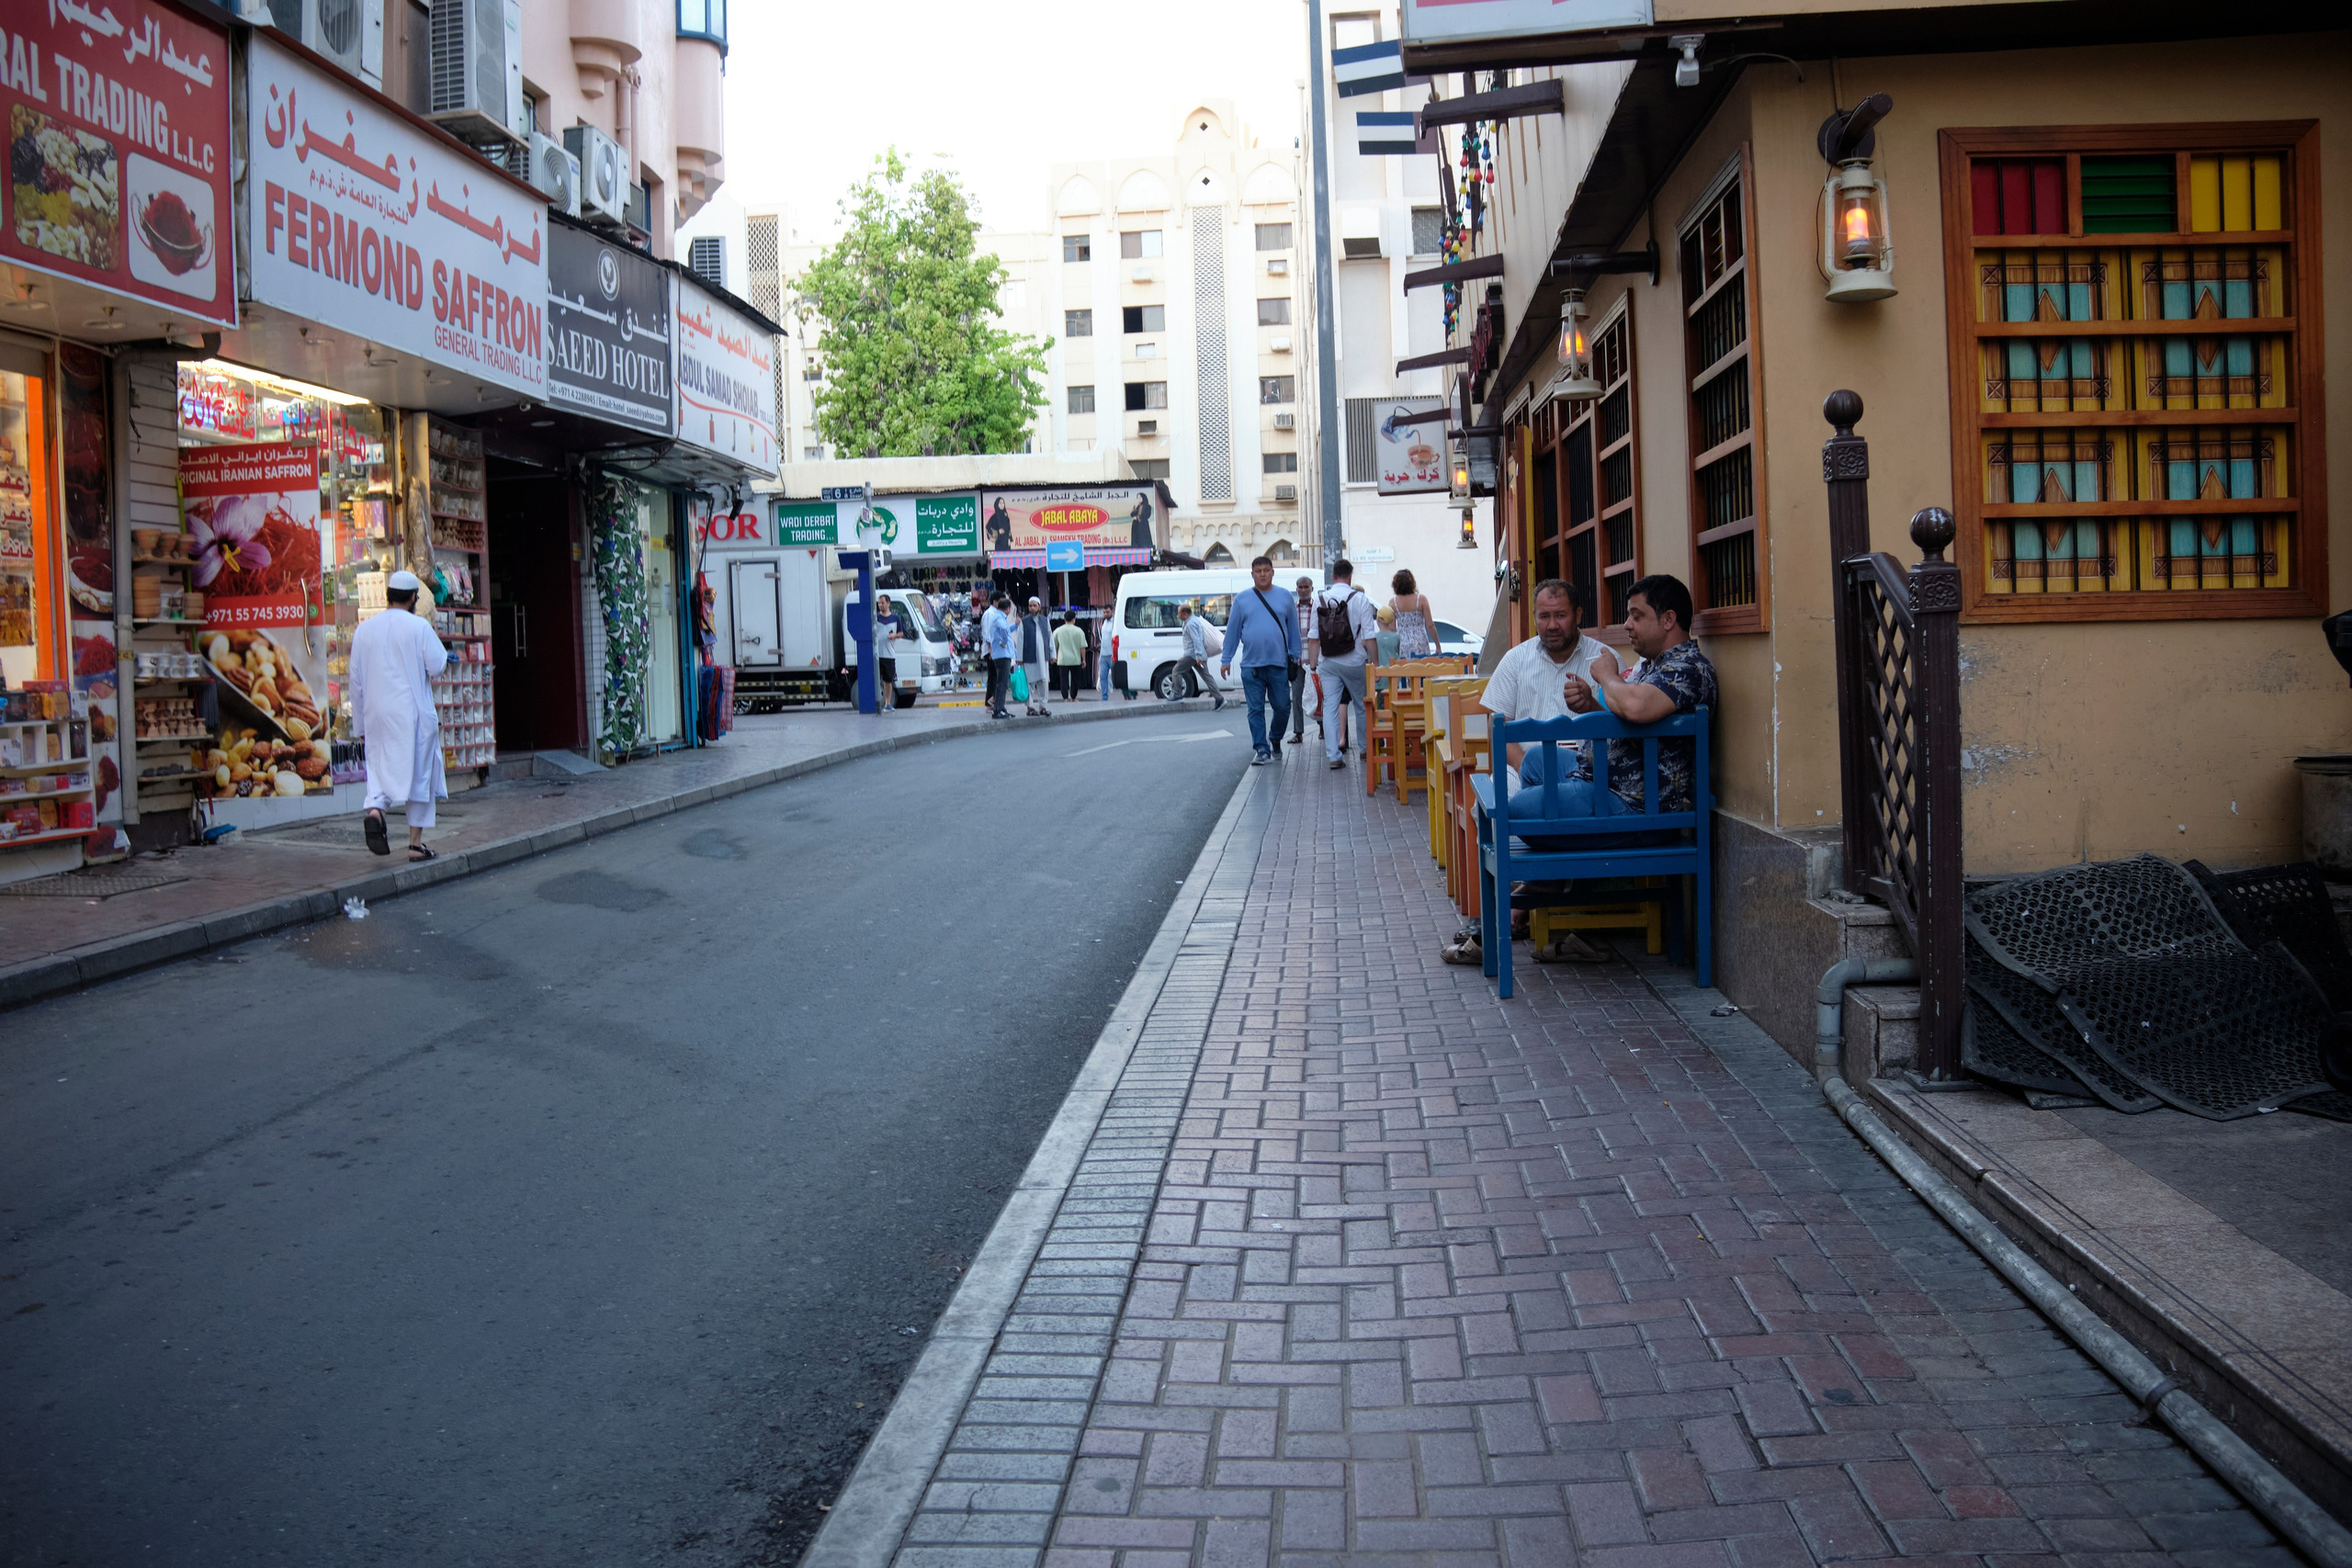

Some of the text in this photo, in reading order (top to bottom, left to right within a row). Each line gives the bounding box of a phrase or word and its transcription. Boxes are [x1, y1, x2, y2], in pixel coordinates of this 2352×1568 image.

[54, 52, 168, 155] TRADING
[173, 130, 214, 174] L.L.C
[265, 83, 540, 265] فرمند زعفران
[349, 178, 377, 209] العامة
[379, 195, 409, 225] للتجارة
[266, 180, 541, 361] FERMOND SAFFRON
[620, 306, 669, 344] فندق
[676, 303, 713, 340] شعيب
[435, 325, 542, 385] GENERAL TRADING L.L.C
[548, 321, 670, 400] SAEED HOTEL
[558, 385, 570, 397] +971
[599, 398, 613, 409] Email:
[706, 365, 732, 406] SAMAD
[180, 464, 311, 484] RIGINAL IRANIAN SAFFRON
[835, 488, 841, 499] 6
[1106, 491, 1129, 500] الجبل
[781, 514, 835, 528] WADI DERBAT
[918, 502, 974, 520] وادي دربات
[1041, 509, 1098, 526] JABAL ABAYA
[791, 530, 825, 541] TRADING
[932, 521, 974, 537] للتجارة
[1014, 537, 1022, 547] AL
[1023, 536, 1039, 546] JABAL
[1077, 534, 1102, 545] TRADING
[1114, 536, 1127, 544] L.L.C
[206, 605, 304, 622] +971 55 745 3930
